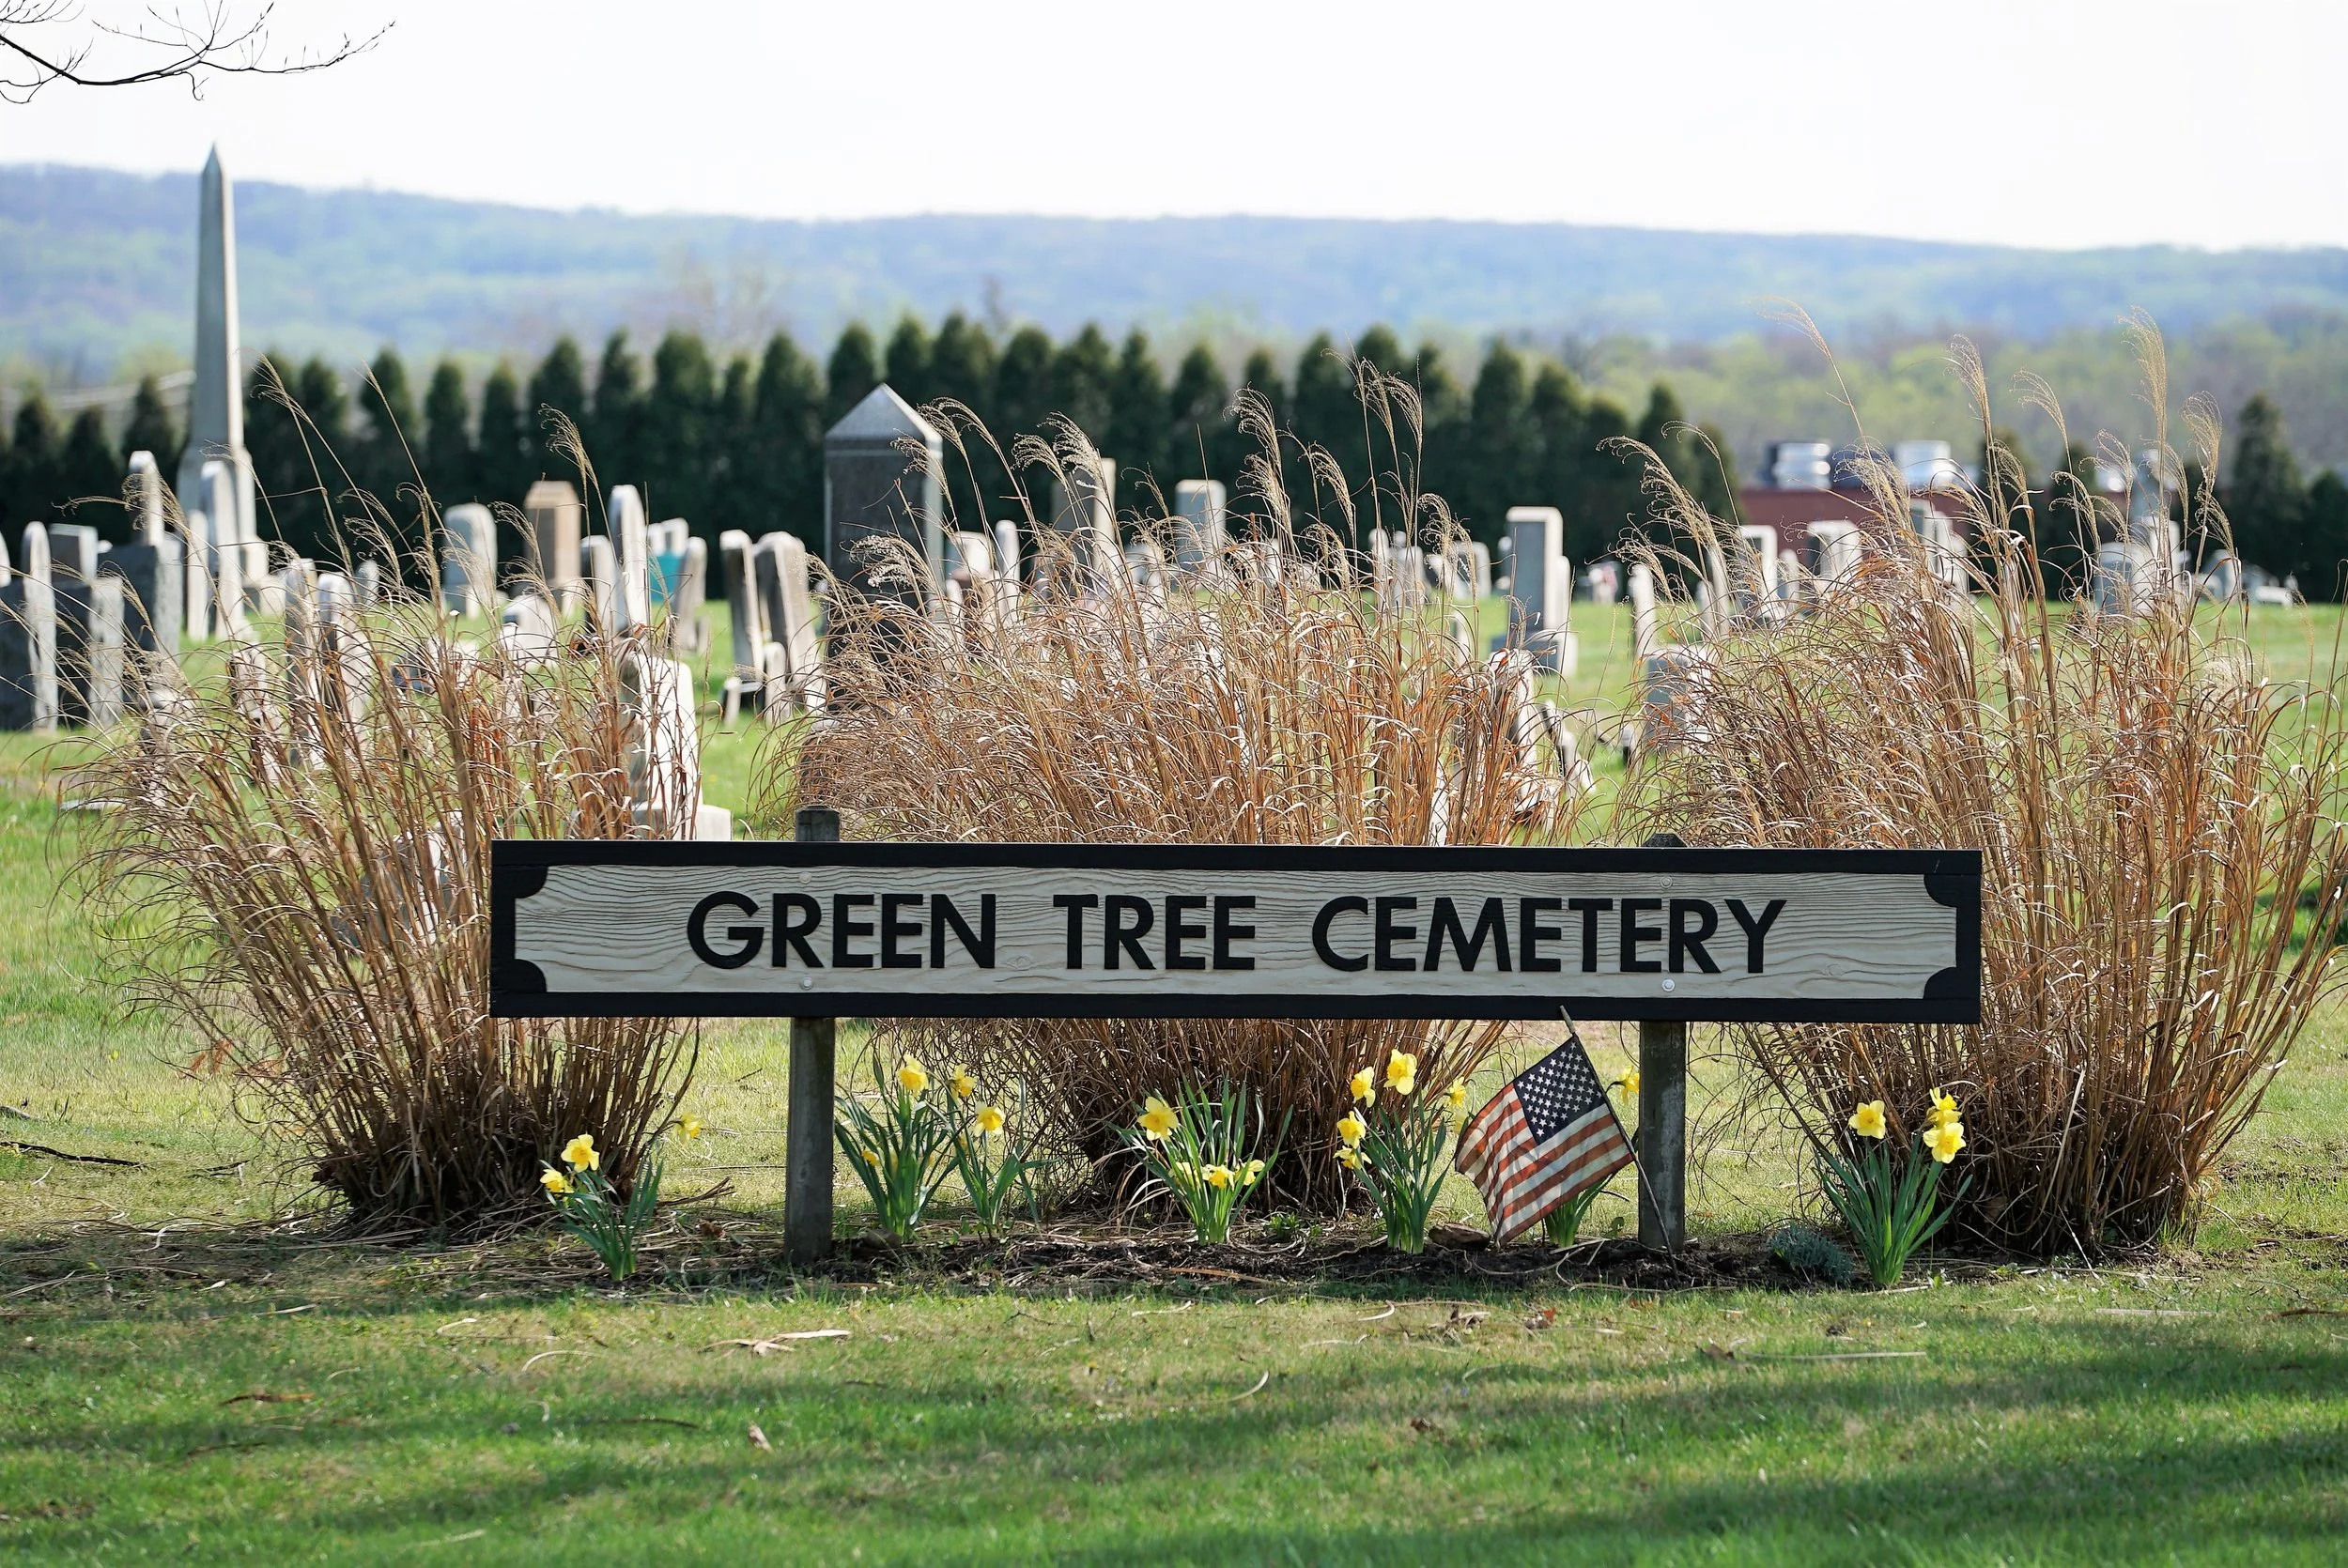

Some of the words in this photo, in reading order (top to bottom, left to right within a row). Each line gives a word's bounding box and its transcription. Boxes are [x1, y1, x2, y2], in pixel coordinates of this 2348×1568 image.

[687, 891, 996, 969] GREEN
[1053, 893, 1256, 970] TREE
[1312, 896, 1787, 974] CEMETERY
